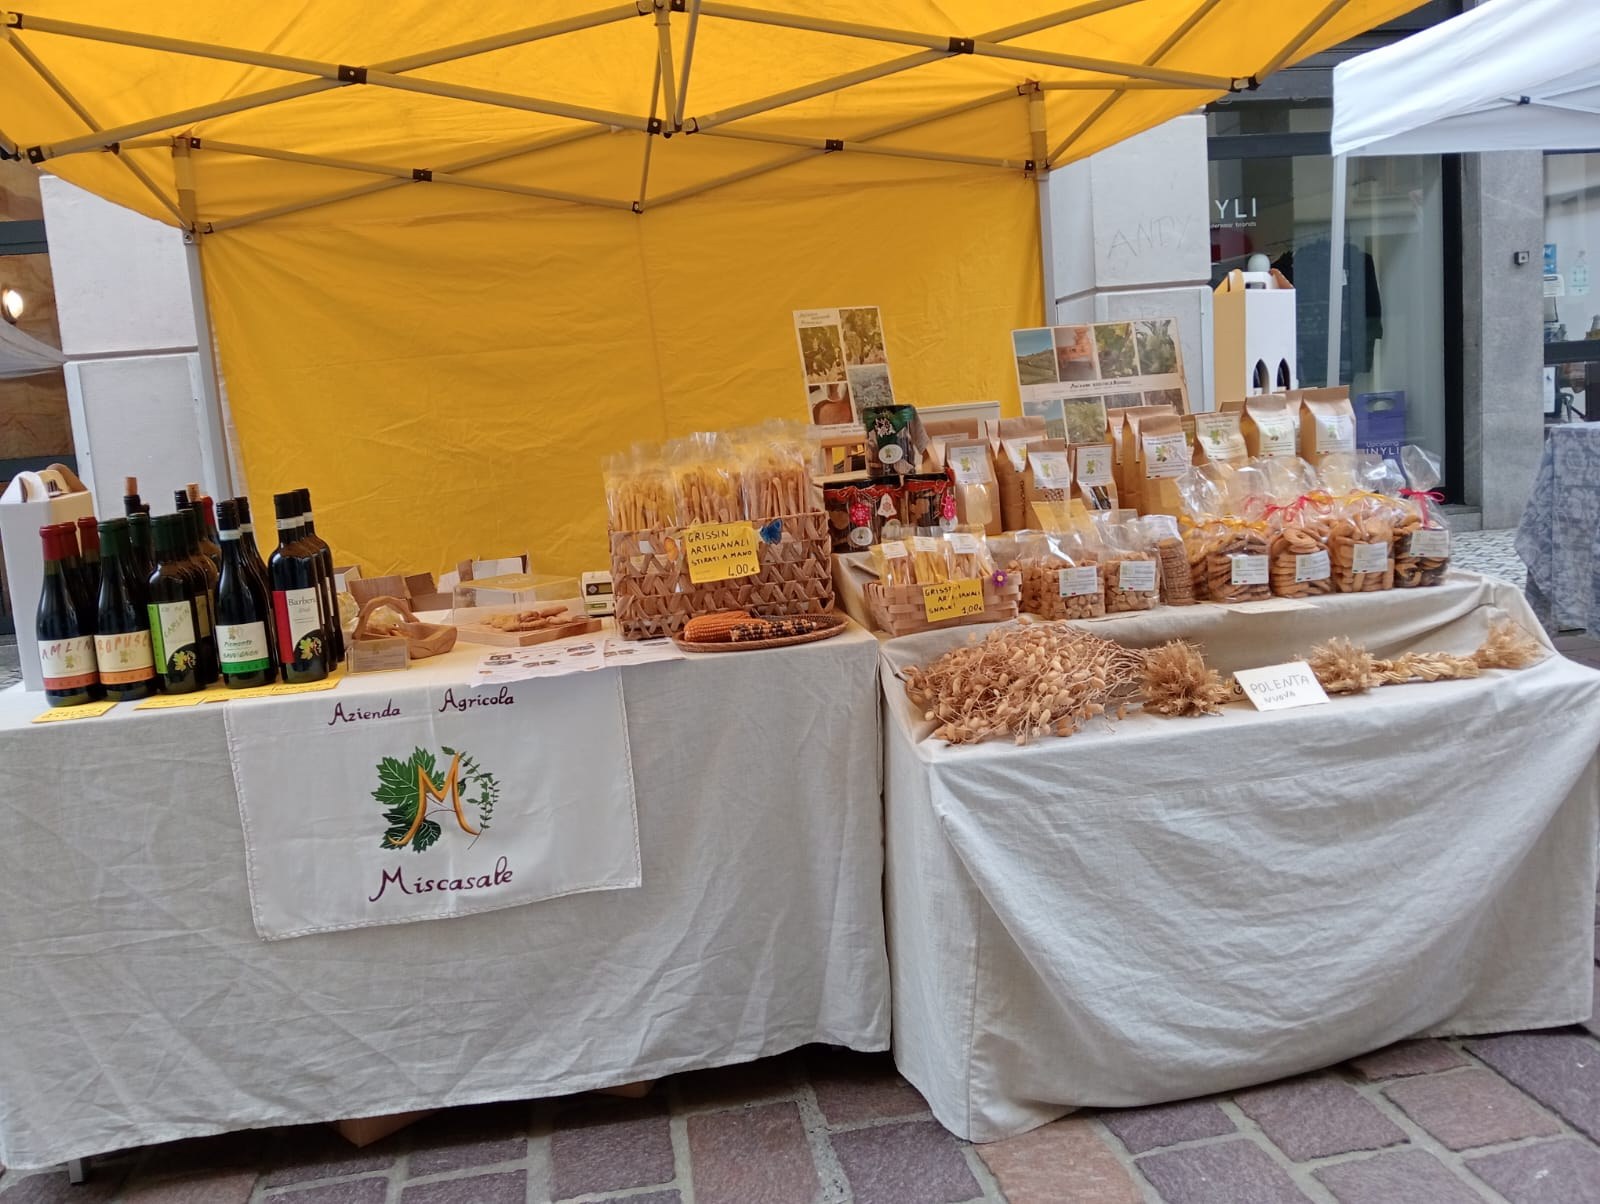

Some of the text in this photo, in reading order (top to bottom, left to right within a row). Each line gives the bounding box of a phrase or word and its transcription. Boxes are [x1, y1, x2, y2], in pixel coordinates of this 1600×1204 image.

[1214, 197, 1257, 219] YLI
[1366, 446, 1399, 456] INYLI
[690, 539, 750, 555] ARTIGIANALI
[1250, 674, 1310, 694] POLENTA
[328, 686, 515, 726] Azienda Agricola
[368, 855, 514, 902] Miscasale
